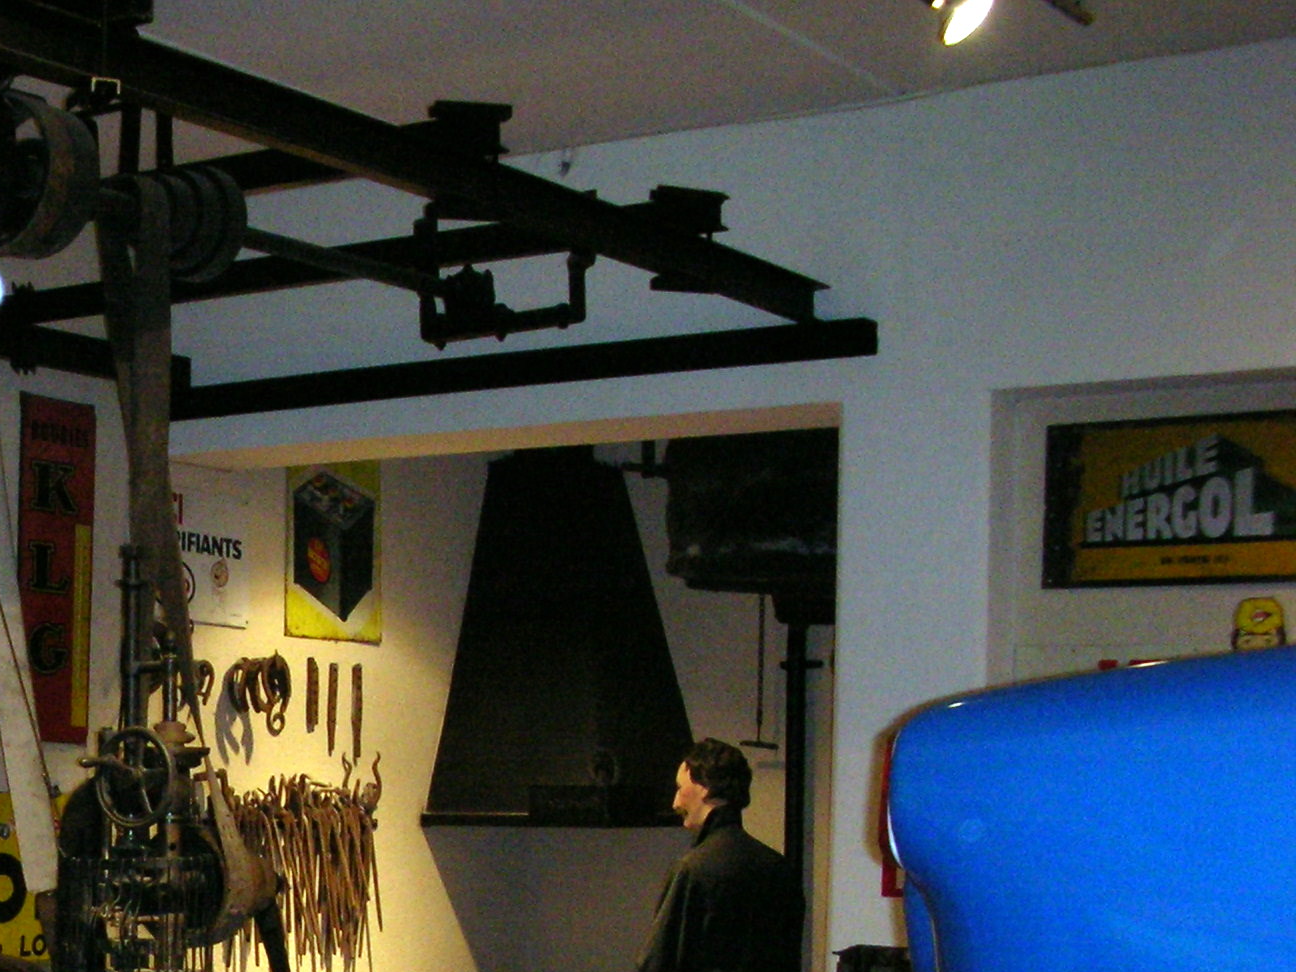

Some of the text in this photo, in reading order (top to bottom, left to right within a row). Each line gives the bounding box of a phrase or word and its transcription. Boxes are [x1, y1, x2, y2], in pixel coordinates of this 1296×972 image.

[1120, 434, 1220, 498] HUILE
[1085, 466, 1276, 542] ENERGOL
[177, 530, 242, 560] IFIANTS
